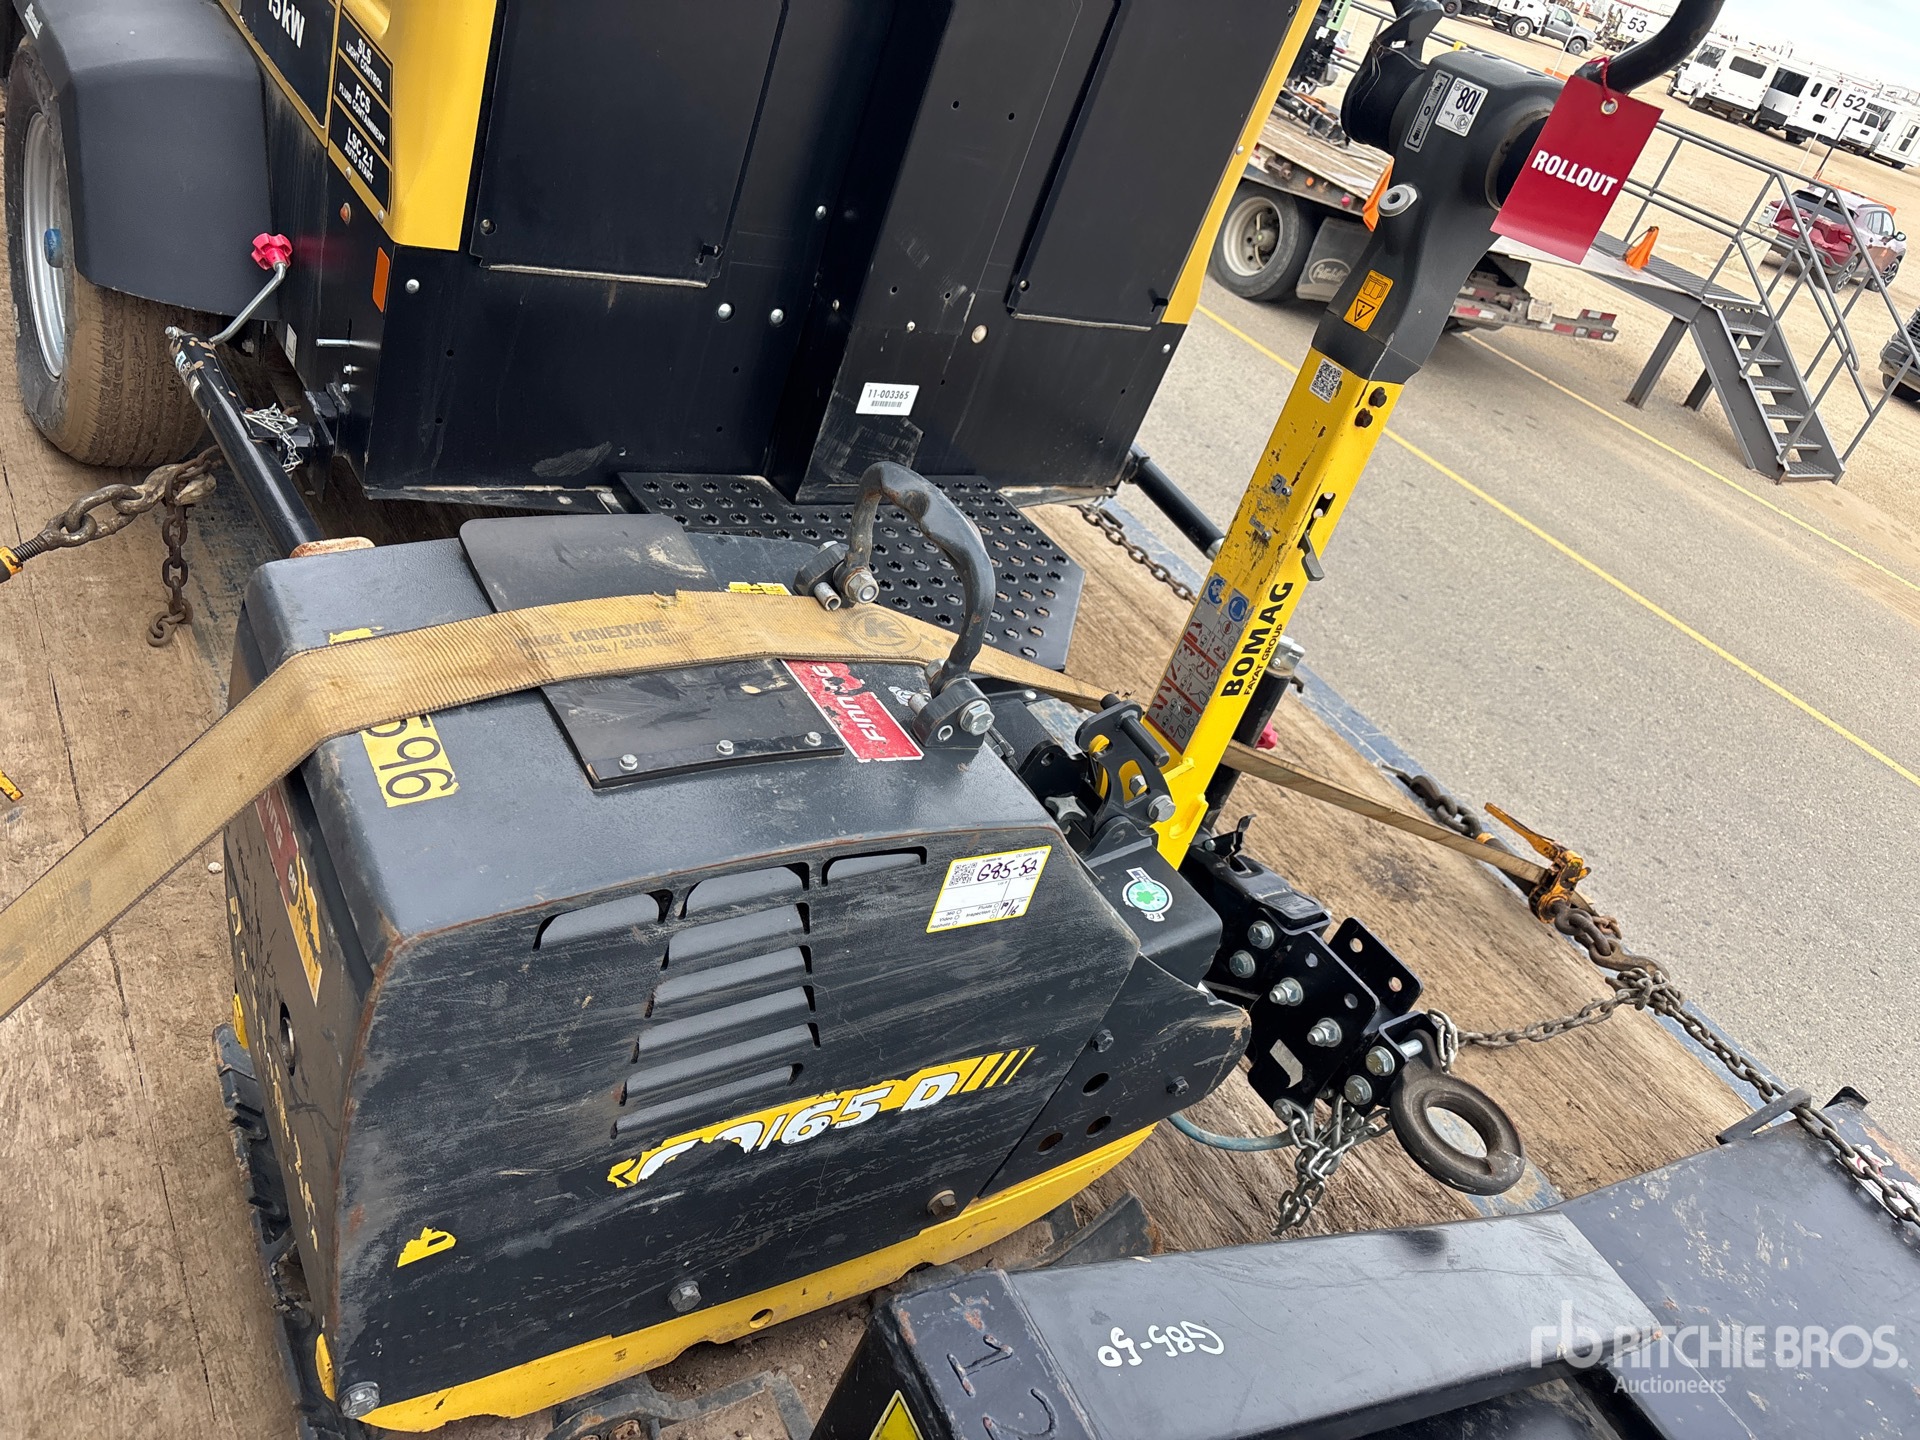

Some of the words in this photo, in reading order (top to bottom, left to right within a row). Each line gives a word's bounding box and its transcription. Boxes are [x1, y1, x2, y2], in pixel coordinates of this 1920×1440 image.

[1627, 16, 1647, 33] 53
[346, 40, 360, 64] LIGHT
[360, 58, 383, 93] CONTROL
[358, 38, 372, 65] SLS
[355, 83, 371, 114] FCS
[1455, 87, 1482, 115] 108
[1842, 93, 1867, 112] 52
[1853, 86, 1869, 95] Lane
[338, 82, 353, 105] FLUID
[351, 99, 386, 146] CONTAINMENT
[347, 126, 362, 156] LSC
[344, 141, 358, 164] AUTO
[358, 158, 375, 184] START
[1531, 149, 1619, 196] ROLLOUT
[867, 388, 910, 400] 11-003365
[1220, 582, 1295, 698] BOMAG
[1243, 664, 1263, 696] FAYAT
[1261, 623, 1284, 661] GROUP
[811, 664, 887, 742] FINNG
[976, 857, 1038, 882] G85-52
[901, 1071, 961, 1112] D
[1097, 1320, 1225, 1368] G85-50
